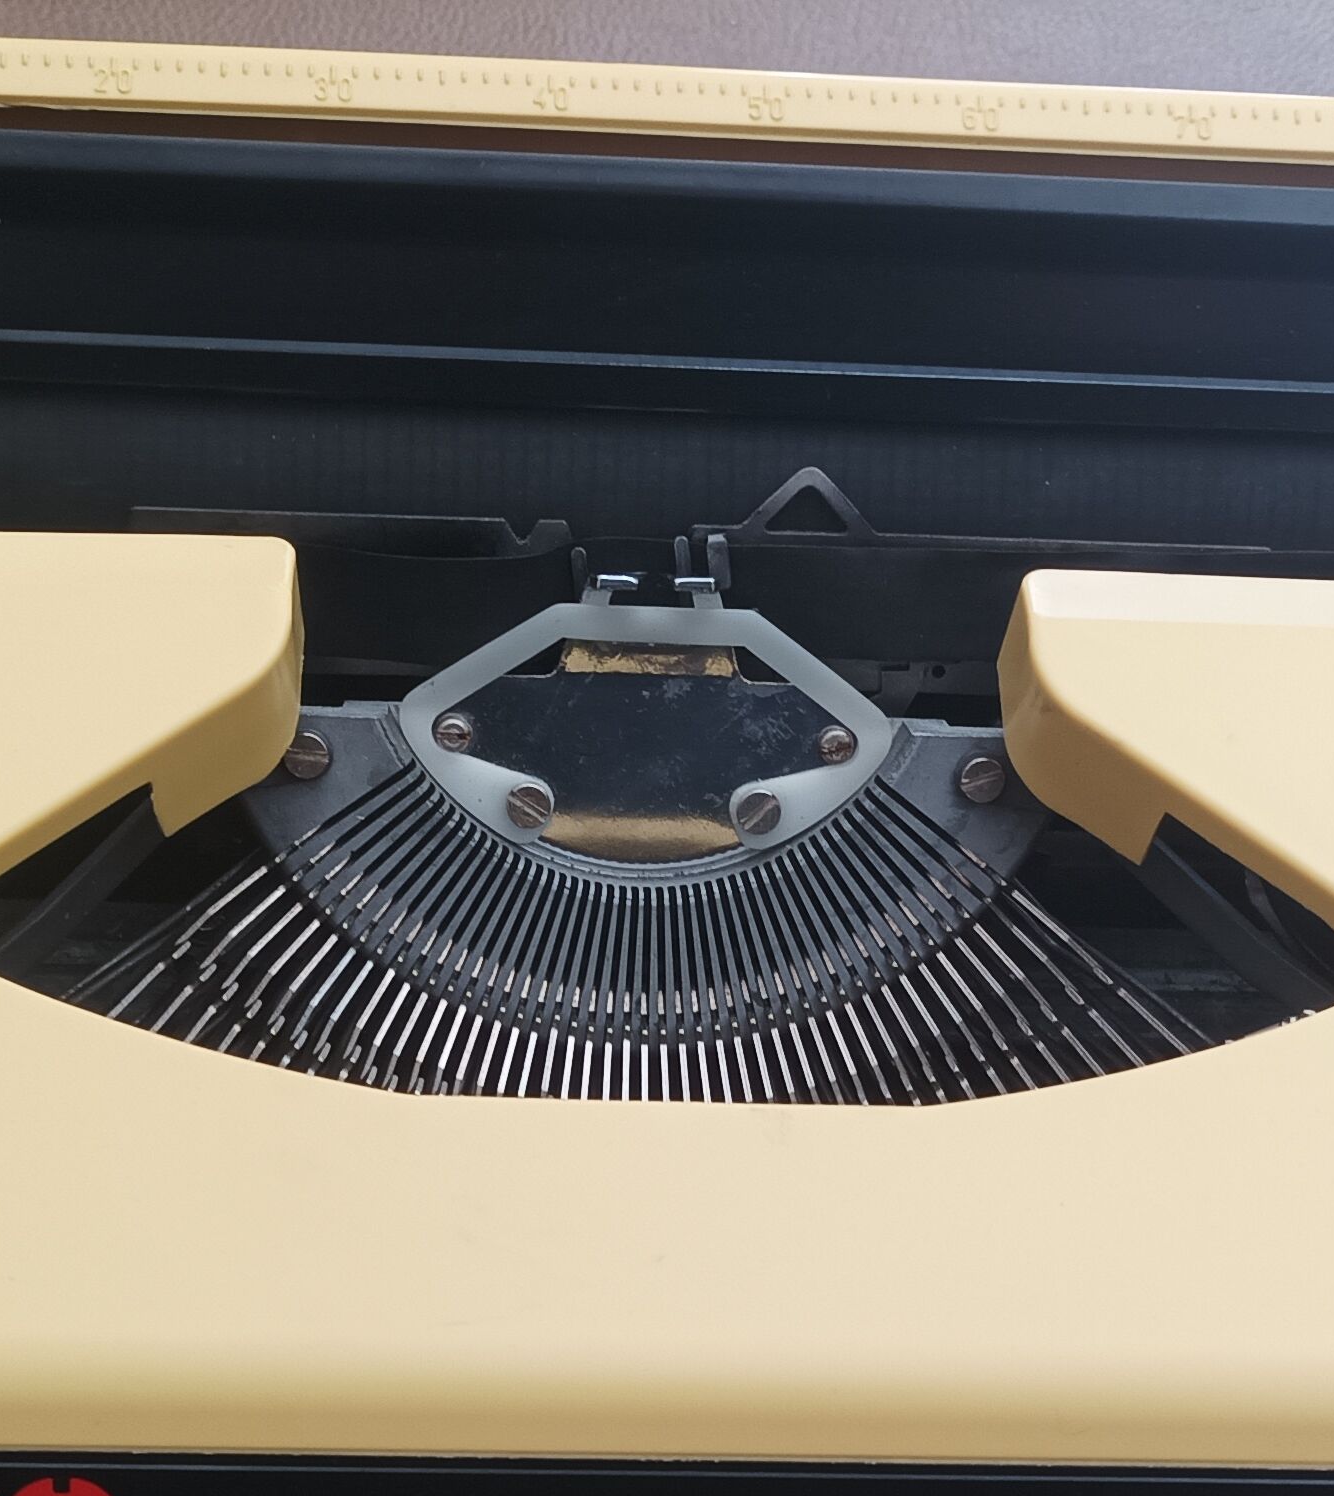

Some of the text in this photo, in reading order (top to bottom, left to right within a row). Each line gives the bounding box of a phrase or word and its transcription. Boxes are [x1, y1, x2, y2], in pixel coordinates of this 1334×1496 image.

[93, 69, 134, 95] 20
[314, 77, 354, 102] 30
[532, 85, 569, 112] 40
[747, 95, 785, 123] 50
[961, 104, 1001, 132] 60
[1171, 114, 1214, 142] 70
